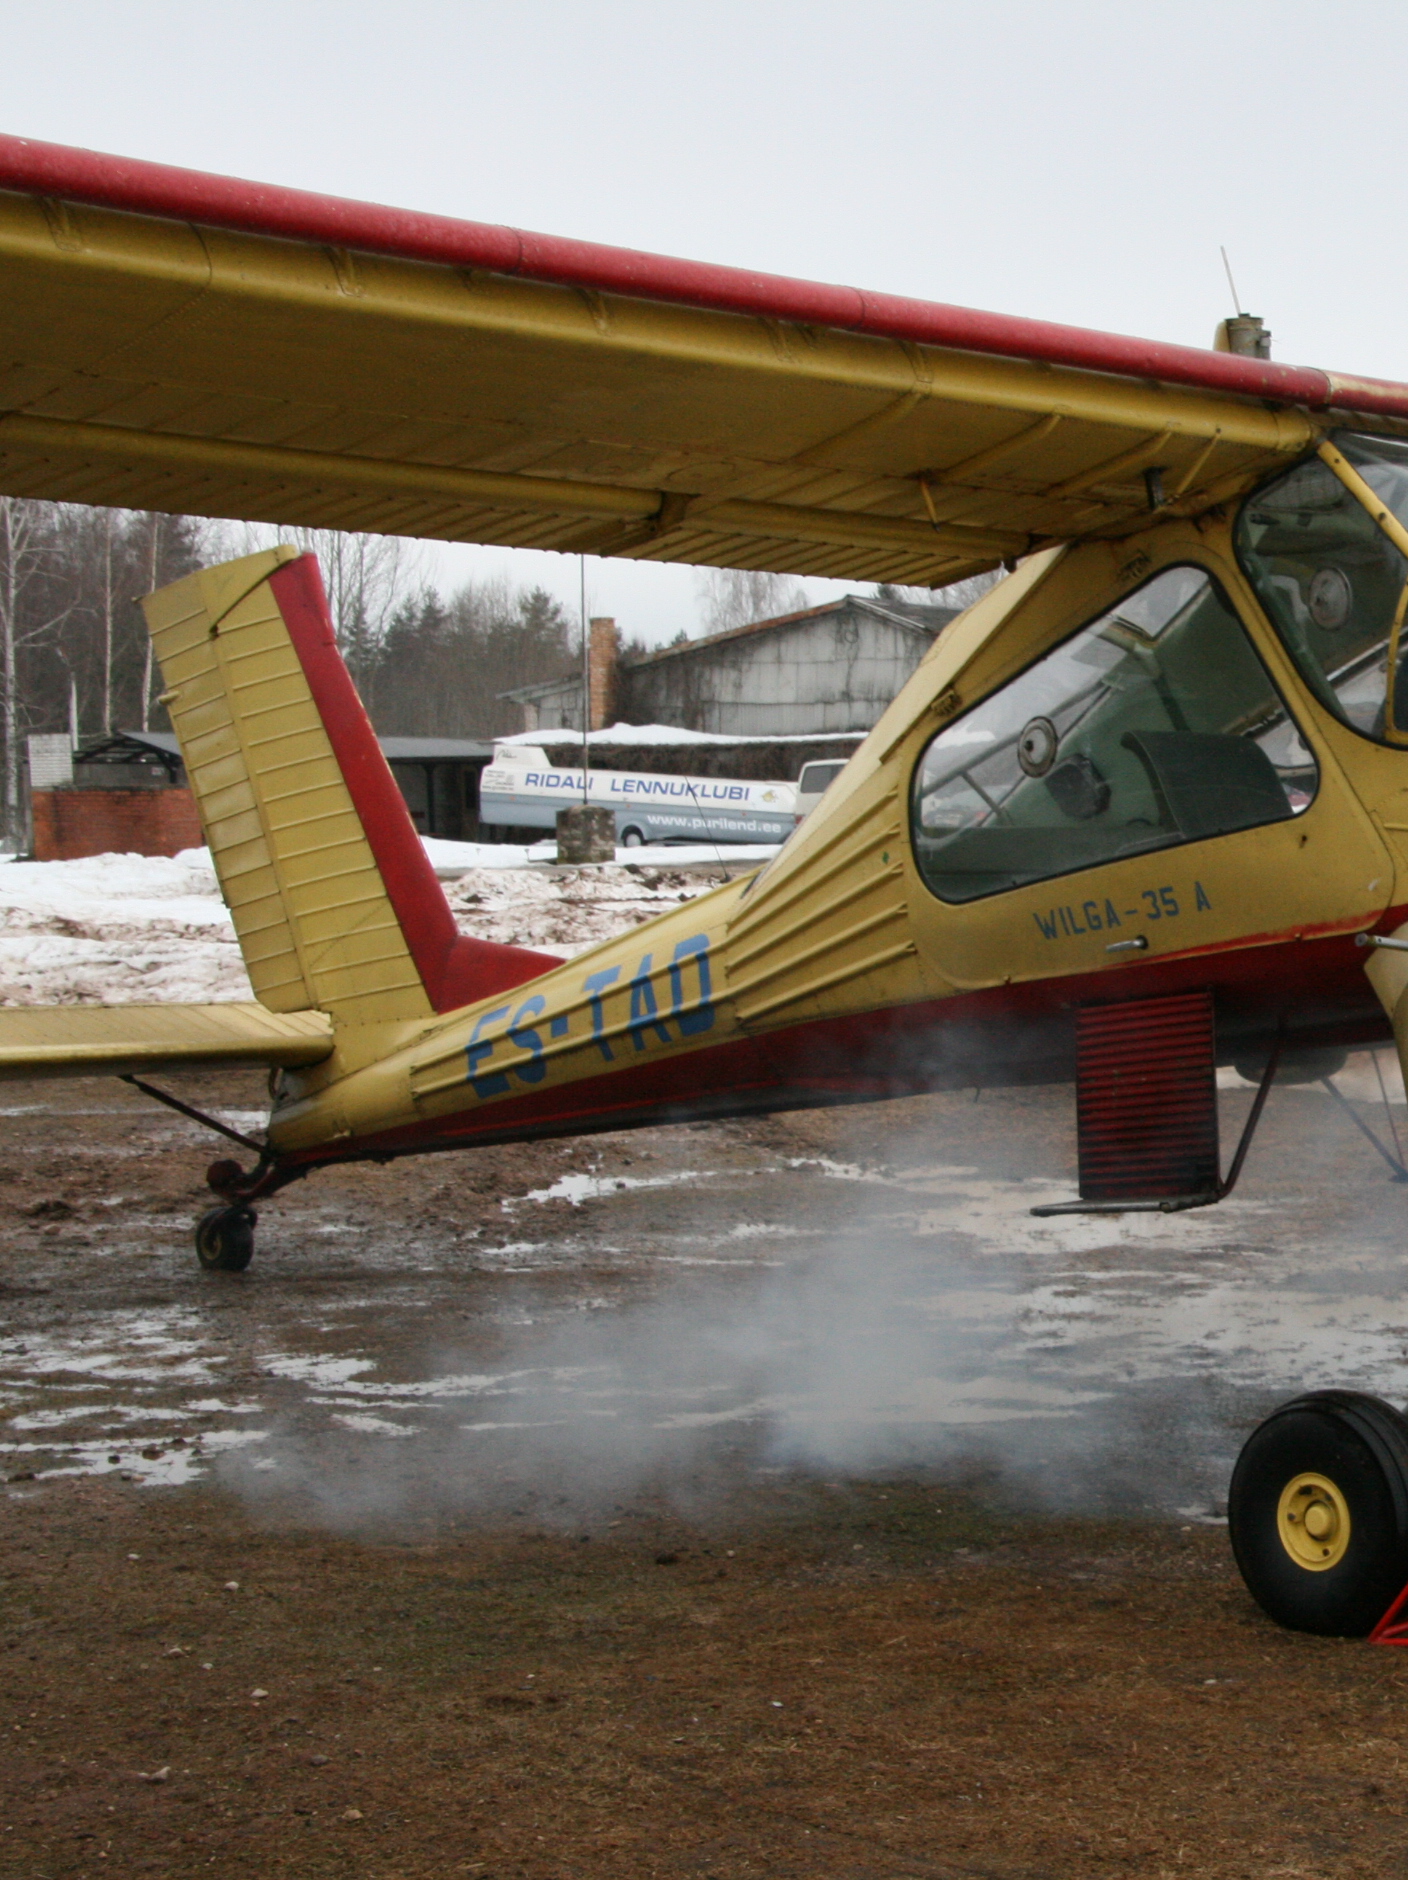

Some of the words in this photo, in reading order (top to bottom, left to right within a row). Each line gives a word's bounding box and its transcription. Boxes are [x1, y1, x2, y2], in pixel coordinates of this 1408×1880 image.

[525, 773, 593, 790] RIDALI
[610, 778, 749, 801] LENNUKLUBI
[647, 814, 781, 834] www.purilend.ee
[1195, 881, 1212, 912] A
